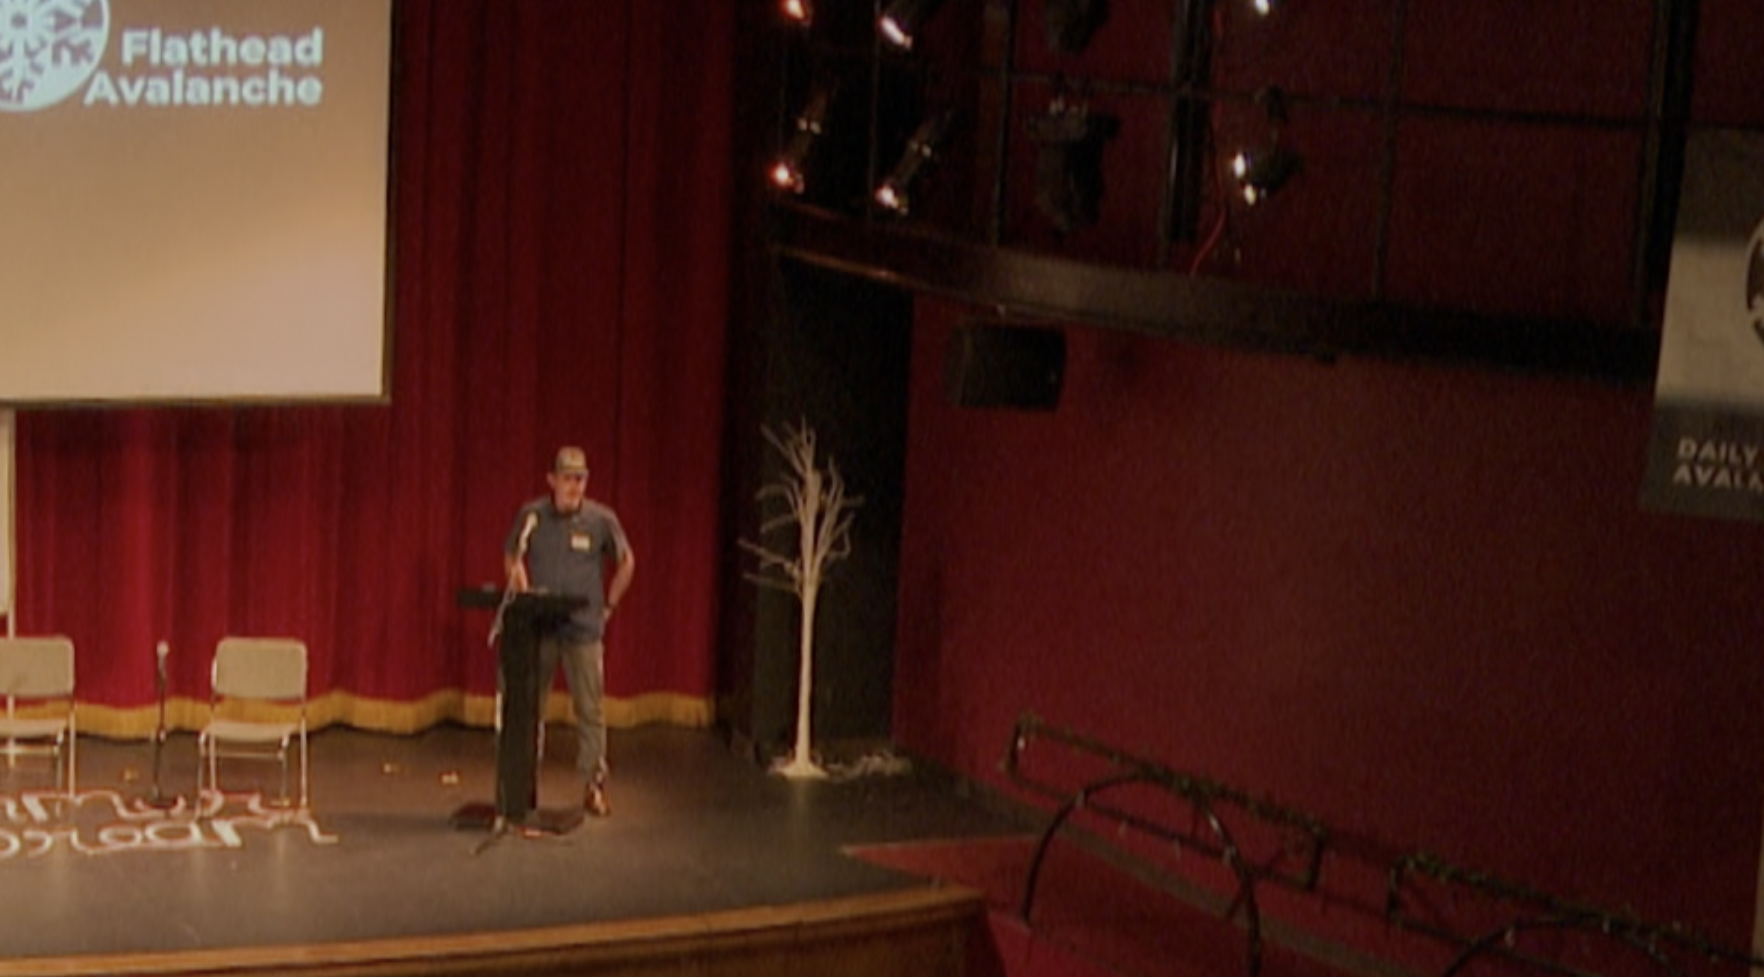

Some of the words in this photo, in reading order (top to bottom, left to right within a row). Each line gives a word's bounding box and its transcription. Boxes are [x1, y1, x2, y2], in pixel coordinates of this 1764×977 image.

[122, 27, 324, 66] Flathead
[83, 69, 324, 106] Avalanche
[1676, 437, 1759, 469] DAILY
